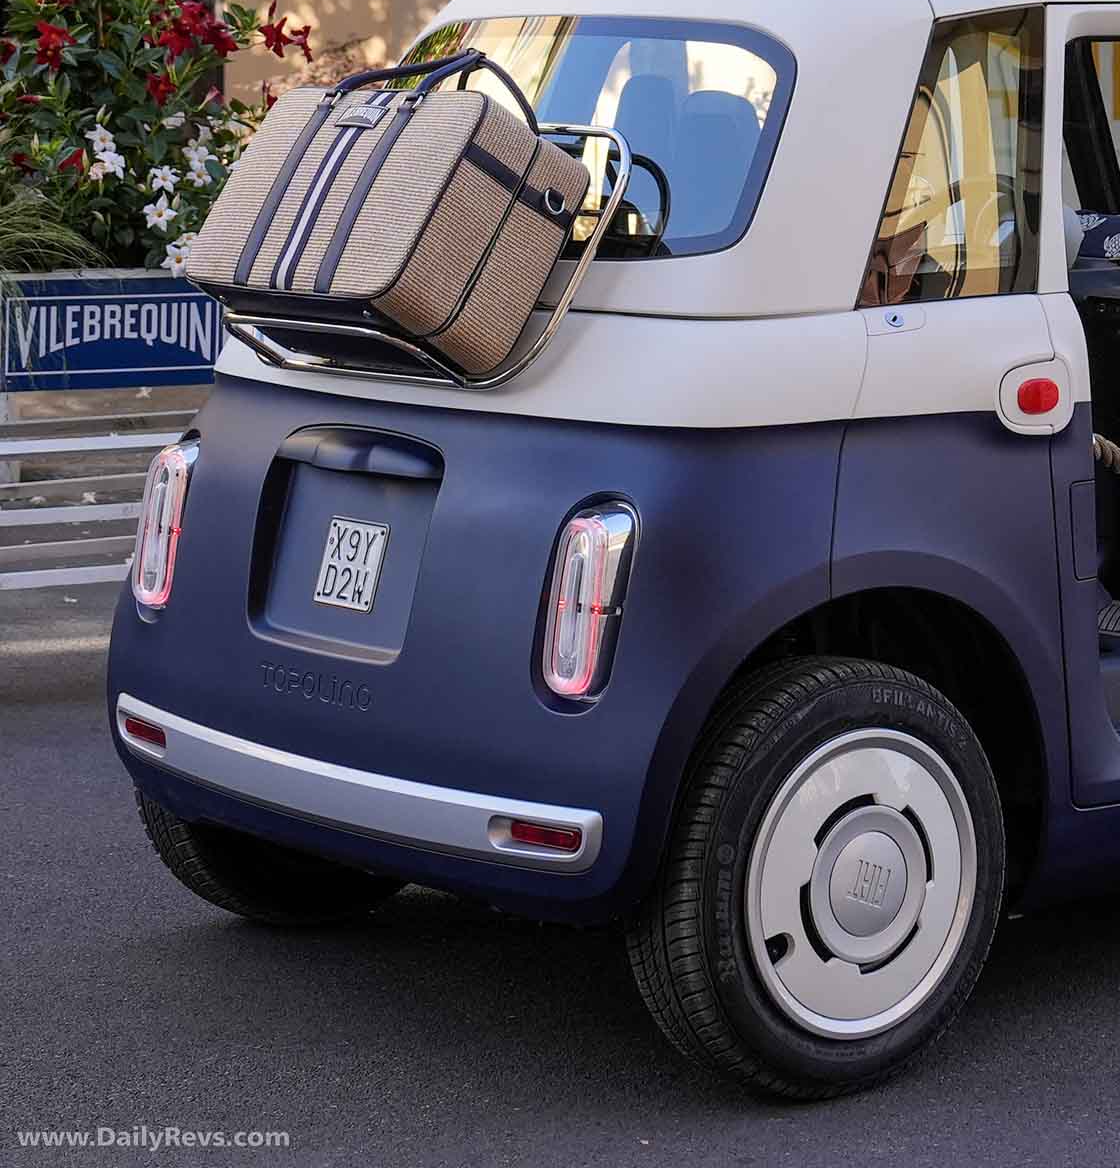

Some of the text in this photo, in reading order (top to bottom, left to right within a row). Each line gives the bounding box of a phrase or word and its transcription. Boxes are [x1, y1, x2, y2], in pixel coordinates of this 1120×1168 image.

[14, 301, 213, 369] VILEBREQUIN
[330, 525, 379, 565] X9Y
[321, 563, 370, 604] D2W
